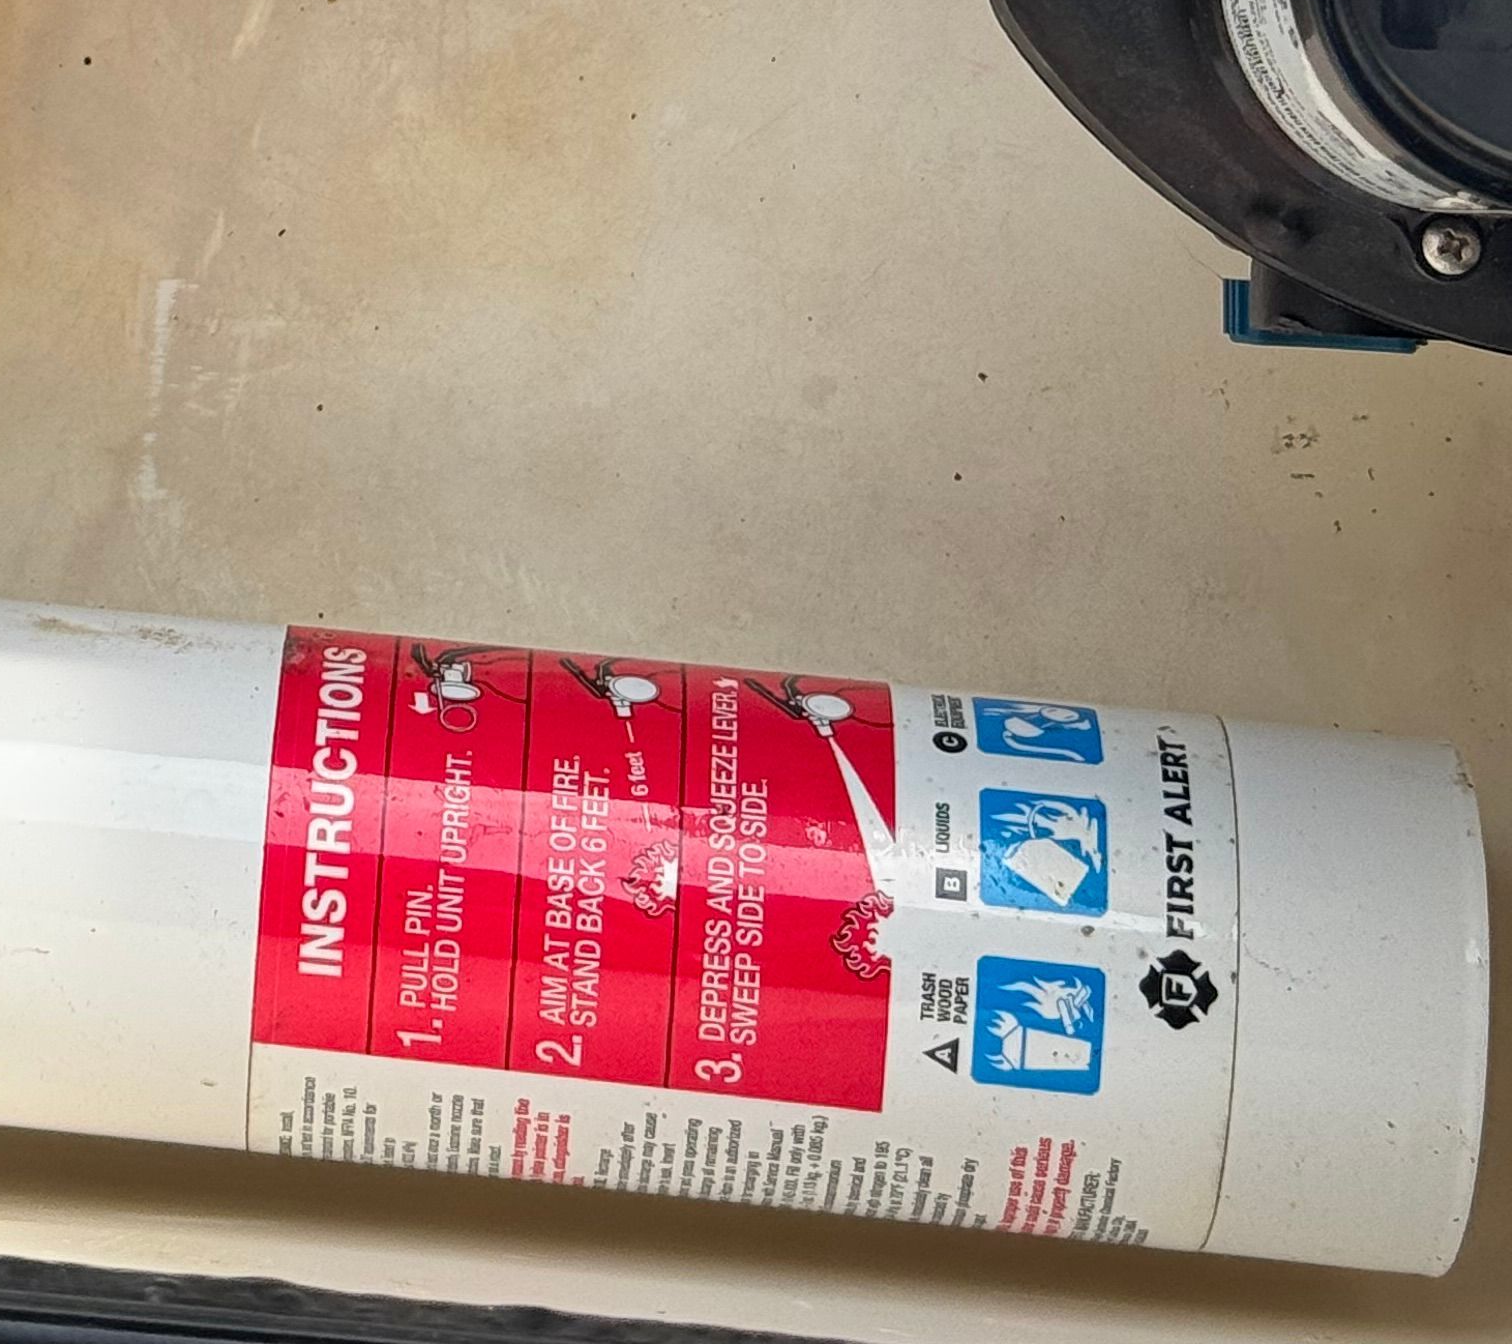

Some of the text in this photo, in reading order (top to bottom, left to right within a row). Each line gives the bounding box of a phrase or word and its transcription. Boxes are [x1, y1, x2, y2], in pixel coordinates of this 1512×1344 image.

[625, 751, 649, 796] 6 feet
[942, 736, 959, 747] C
[297, 646, 367, 978] INSTRUCTIONS
[935, 802, 949, 853] LIQUIDS
[1157, 733, 1195, 940] FIRST ALERT
[431, 749, 474, 1012] HOLD UNIT UPRIGHT.
[535, 754, 583, 1067] 2. AIM AT BASE OF FIRE.
[571, 767, 612, 1028] STAND BACK 6 FEET.
[694, 689, 744, 1084] 3. DEPRESS AND SQUEEZE LEVER.
[730, 779, 769, 1045] SWEEP SIDE TO SIDE.
[944, 877, 961, 892] B
[397, 884, 443, 1048] 1. PULL PIN.
[920, 972, 936, 1021] TRASH
[937, 979, 953, 1022] WOOD
[953, 977, 970, 1024] PAPER
[932, 1047, 952, 1062] A
